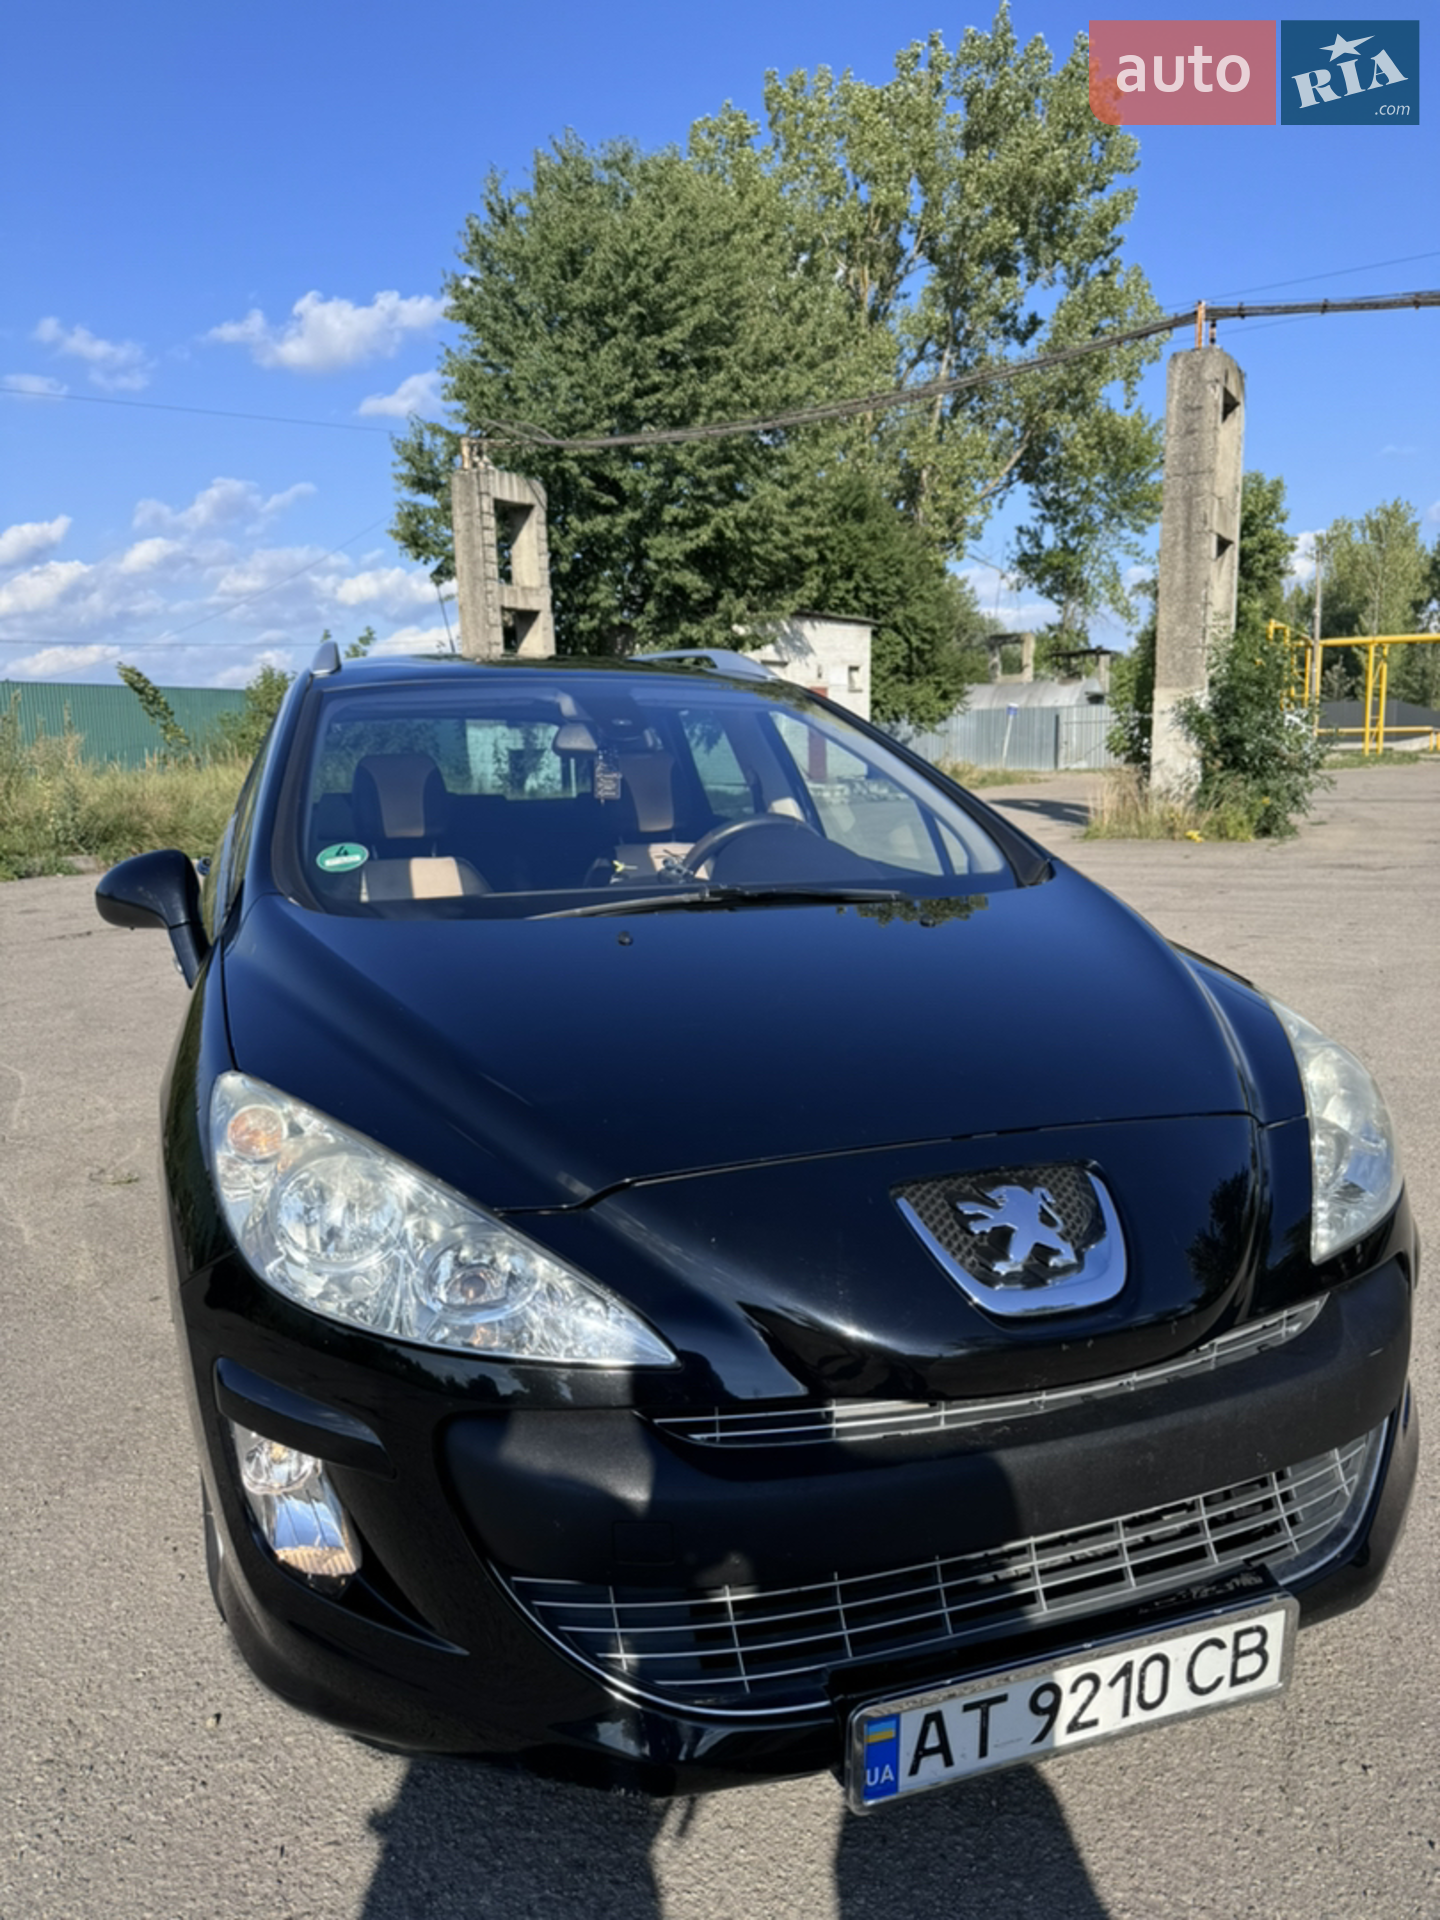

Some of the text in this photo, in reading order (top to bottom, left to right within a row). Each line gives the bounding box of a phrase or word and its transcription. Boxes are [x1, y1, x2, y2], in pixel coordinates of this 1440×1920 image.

[908, 1625, 1270, 1777] AT 9210 CB
[866, 1764, 895, 1787] UA
